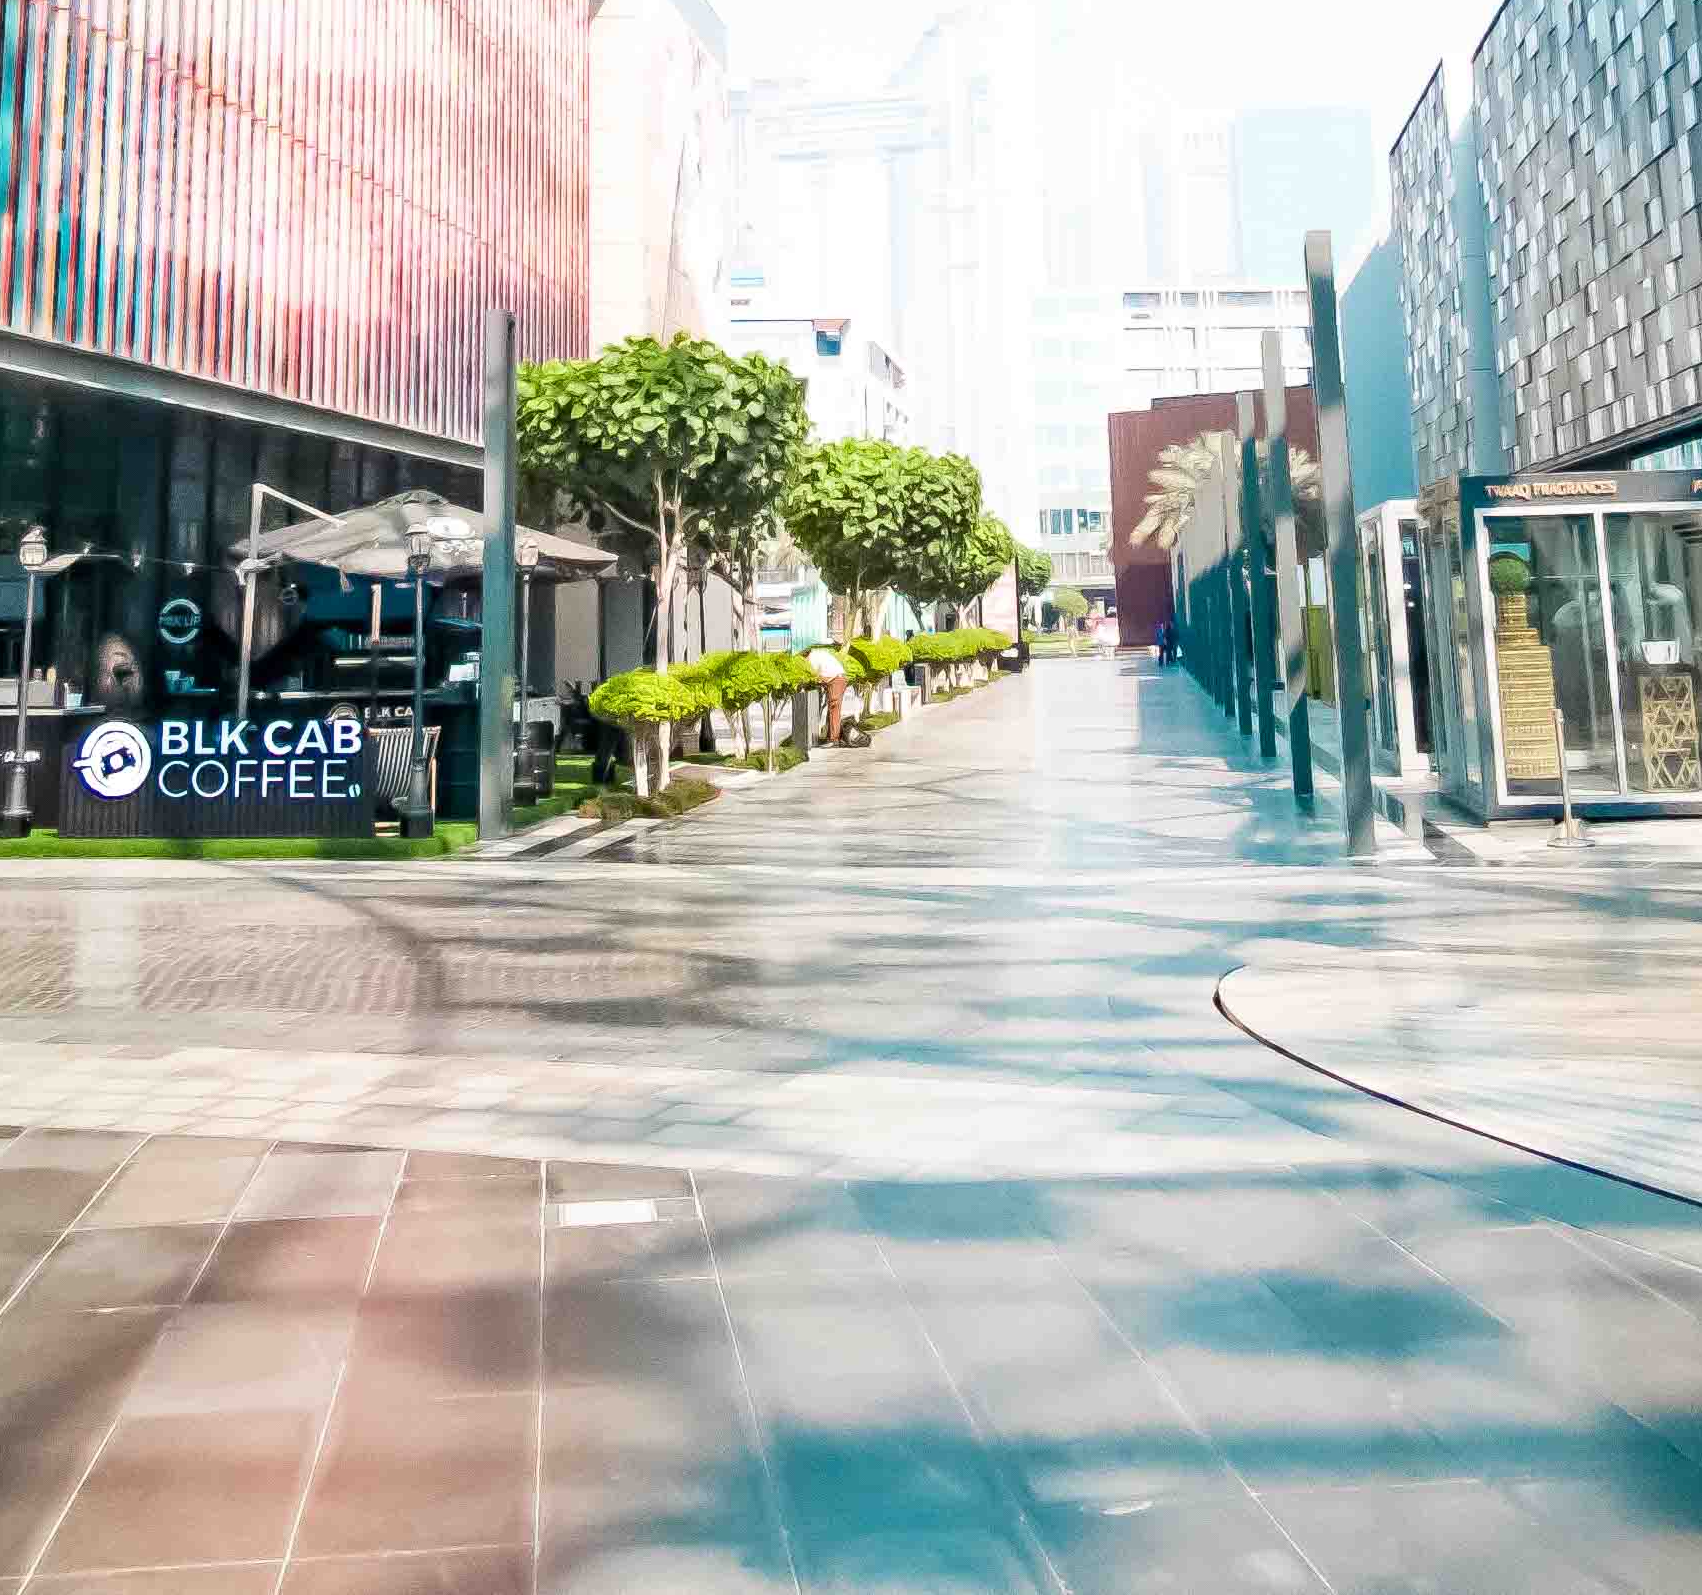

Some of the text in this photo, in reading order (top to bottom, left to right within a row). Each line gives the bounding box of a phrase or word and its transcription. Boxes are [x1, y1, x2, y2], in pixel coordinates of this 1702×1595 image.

[1533, 480, 1618, 497] FRAGRANCES
[161, 718, 363, 756] BLK CAB
[158, 758, 349, 798] COFFEE
